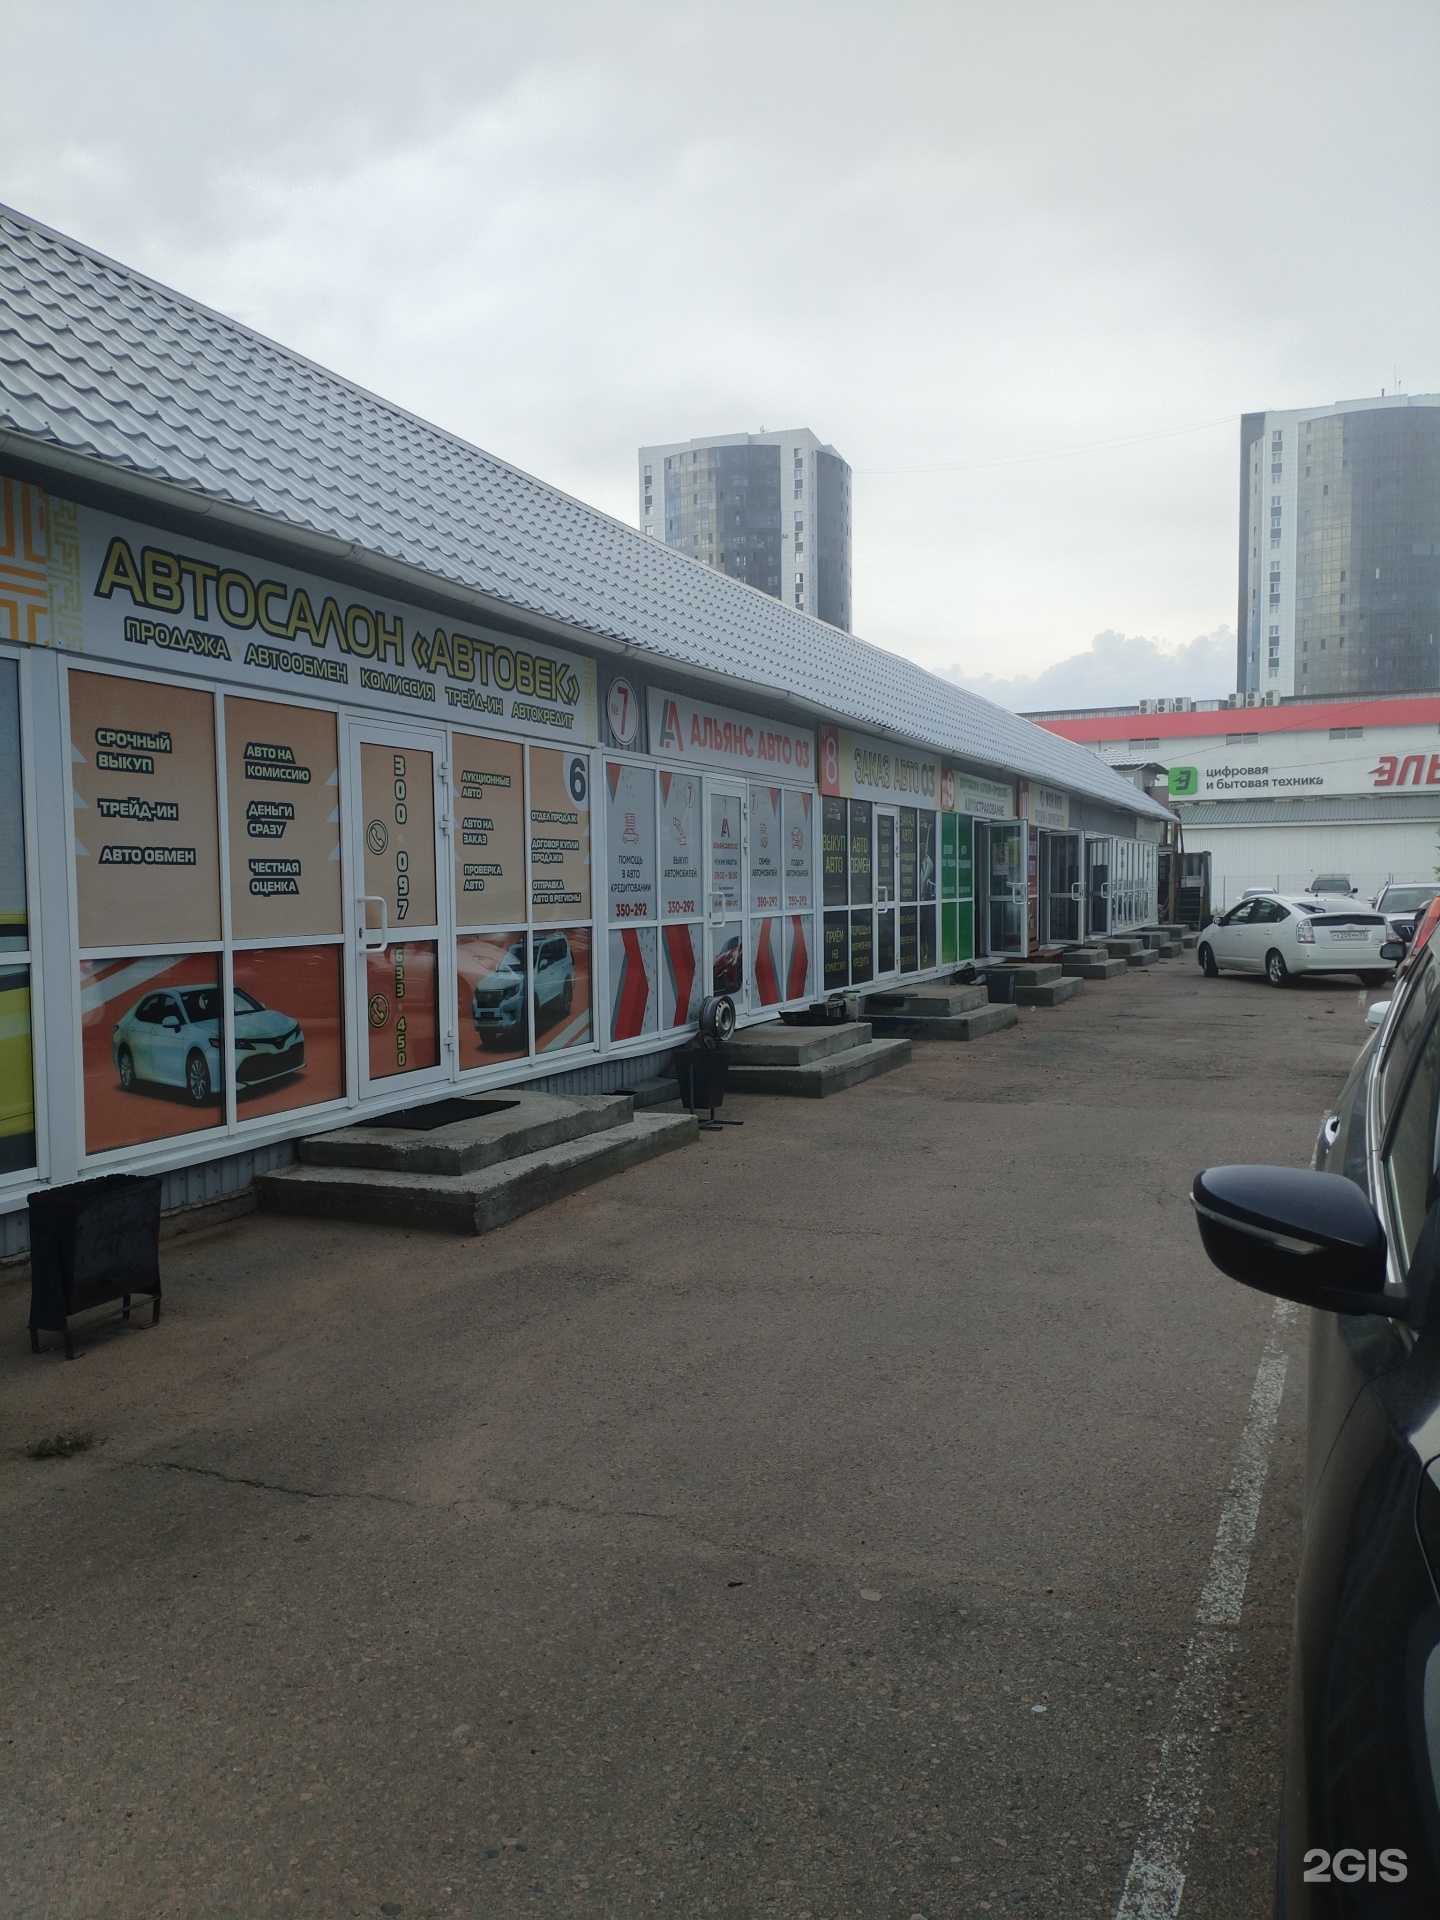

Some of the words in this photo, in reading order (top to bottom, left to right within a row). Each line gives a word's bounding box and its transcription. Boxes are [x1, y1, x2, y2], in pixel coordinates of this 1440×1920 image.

[94, 537, 404, 668] АВТОСАЛОН
[412, 627, 580, 706] «АВТОВЕК»
[124, 616, 231, 661] ПРОДАЖА
[244, 643, 348, 684] АВТООБМЕН
[360, 667, 435, 701] КОМИССИЯ
[445, 687, 503, 716] ТРЕЙД-ИН
[511, 703, 575, 729] АВТОКРЕДИТ
[617, 687, 628, 735] 7
[97, 729, 171, 752] СРОЧНЫЙ
[690, 713, 754, 758] АЛЬЯНС
[758, 731, 791, 765] АВТО
[795, 736, 809, 768] 03
[245, 743, 276, 760] АВТО
[277, 747, 294, 762] НА
[826, 736, 838, 784] 8
[97, 752, 153, 773] ВЫКУП
[246, 764, 311, 783] КОМИССИЮ
[462, 771, 511, 787] АУКЦИОННЫЕ
[570, 758, 586, 801] 6
[894, 757, 920, 794] АВТО
[1206, 765, 1269, 778] цифровая
[1206, 781, 1214, 790] и
[1216, 778, 1269, 790] бытовая
[1271, 777, 1323, 789] техника
[462, 786, 482, 799] АВТО
[99, 798, 178, 819] ТРЕЙД-ИН
[247, 802, 294, 819] ДЕНЬГИ
[248, 822, 285, 838] СРАЗУ
[463, 818, 482, 829] АВТО
[483, 819, 493, 831] НА
[463, 834, 487, 845] ЗАКАЗ
[101, 847, 142, 863] АВТО
[144, 847, 196, 864] ОБМЕН
[249, 860, 301, 876] ЧЕСТНАЯ
[464, 864, 502, 875] ПРОВЕРКА
[826, 856, 843, 873] АВТО
[250, 878, 298, 895] ОЦЕНКА
[464, 880, 484, 891] АВТО
[616, 903, 647, 917] 350-292
[667, 900, 695, 913] 350-292
